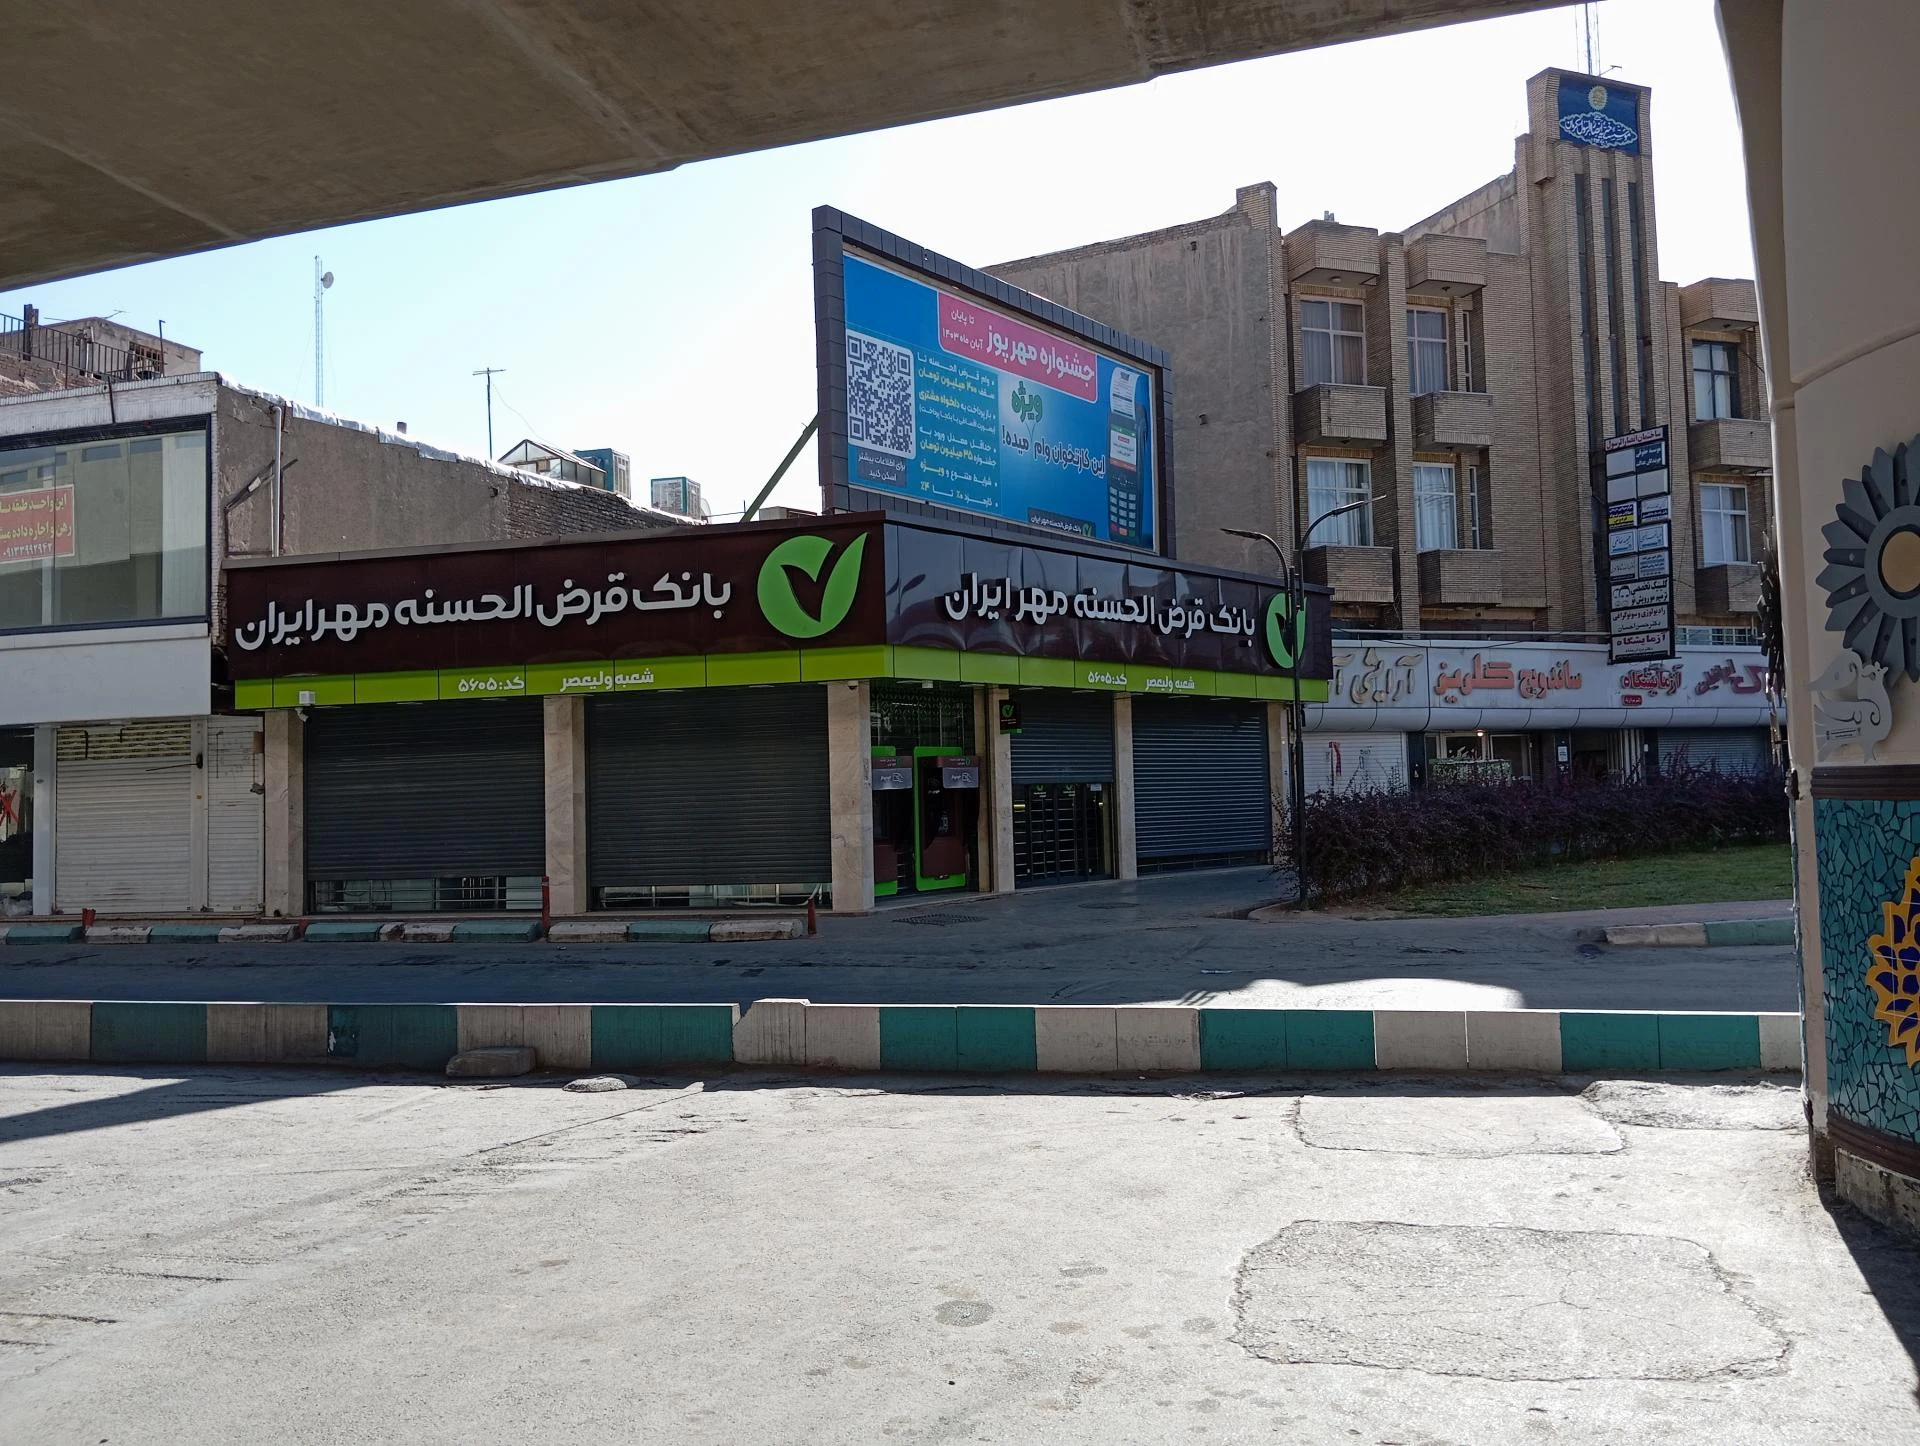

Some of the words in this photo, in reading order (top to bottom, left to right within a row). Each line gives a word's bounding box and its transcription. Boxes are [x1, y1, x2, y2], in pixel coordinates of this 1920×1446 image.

[951, 309, 967, 326] پایان
[969, 314, 975, 324] تا
[942, 327, 959, 342] ۱۴۰۳
[960, 336, 969, 344] ماه
[970, 338, 984, 350] آبان
[987, 326, 1009, 364] پوز
[918, 352, 927, 362] تا
[1010, 340, 1037, 366] مهر
[919, 367, 940, 382] تومان
[1040, 347, 1094, 388] جشنواره
[941, 376, 966, 391] میلیون
[1012, 380, 1043, 422] ویژه
[920, 440, 940, 453] تومان
[940, 447, 964, 460] میلیون
[1034, 438, 1050, 463] وام
[1052, 442, 1090, 473] کارتخوان
[1091, 455, 1105, 478] این
[29, 521, 49, 540] اجاره
[56, 522, 72, 537] رهن
[395, 584, 532, 626] الحسنه
[536, 572, 629, 627] قرض
[632, 571, 731, 619] بانک
[945, 572, 1011, 621] ایران
[1015, 587, 1068, 625] مهر
[1073, 587, 1155, 624] الحسنه
[235, 598, 313, 651] ایران
[311, 602, 390, 642] مهر
[1158, 598, 1206, 639] قرض
[1209, 603, 1255, 647] بانک
[1617, 631, 1666, 646] آزمایشگاه
[560, 671, 613, 692] ولیعصر
[615, 668, 655, 687] شعبه
[1146, 677, 1174, 692] ولیعصر
[1175, 676, 1195, 692] شعبه
[1518, 659, 1583, 699] ساندویچ
[1622, 663, 1684, 697] آزمایشگاه
